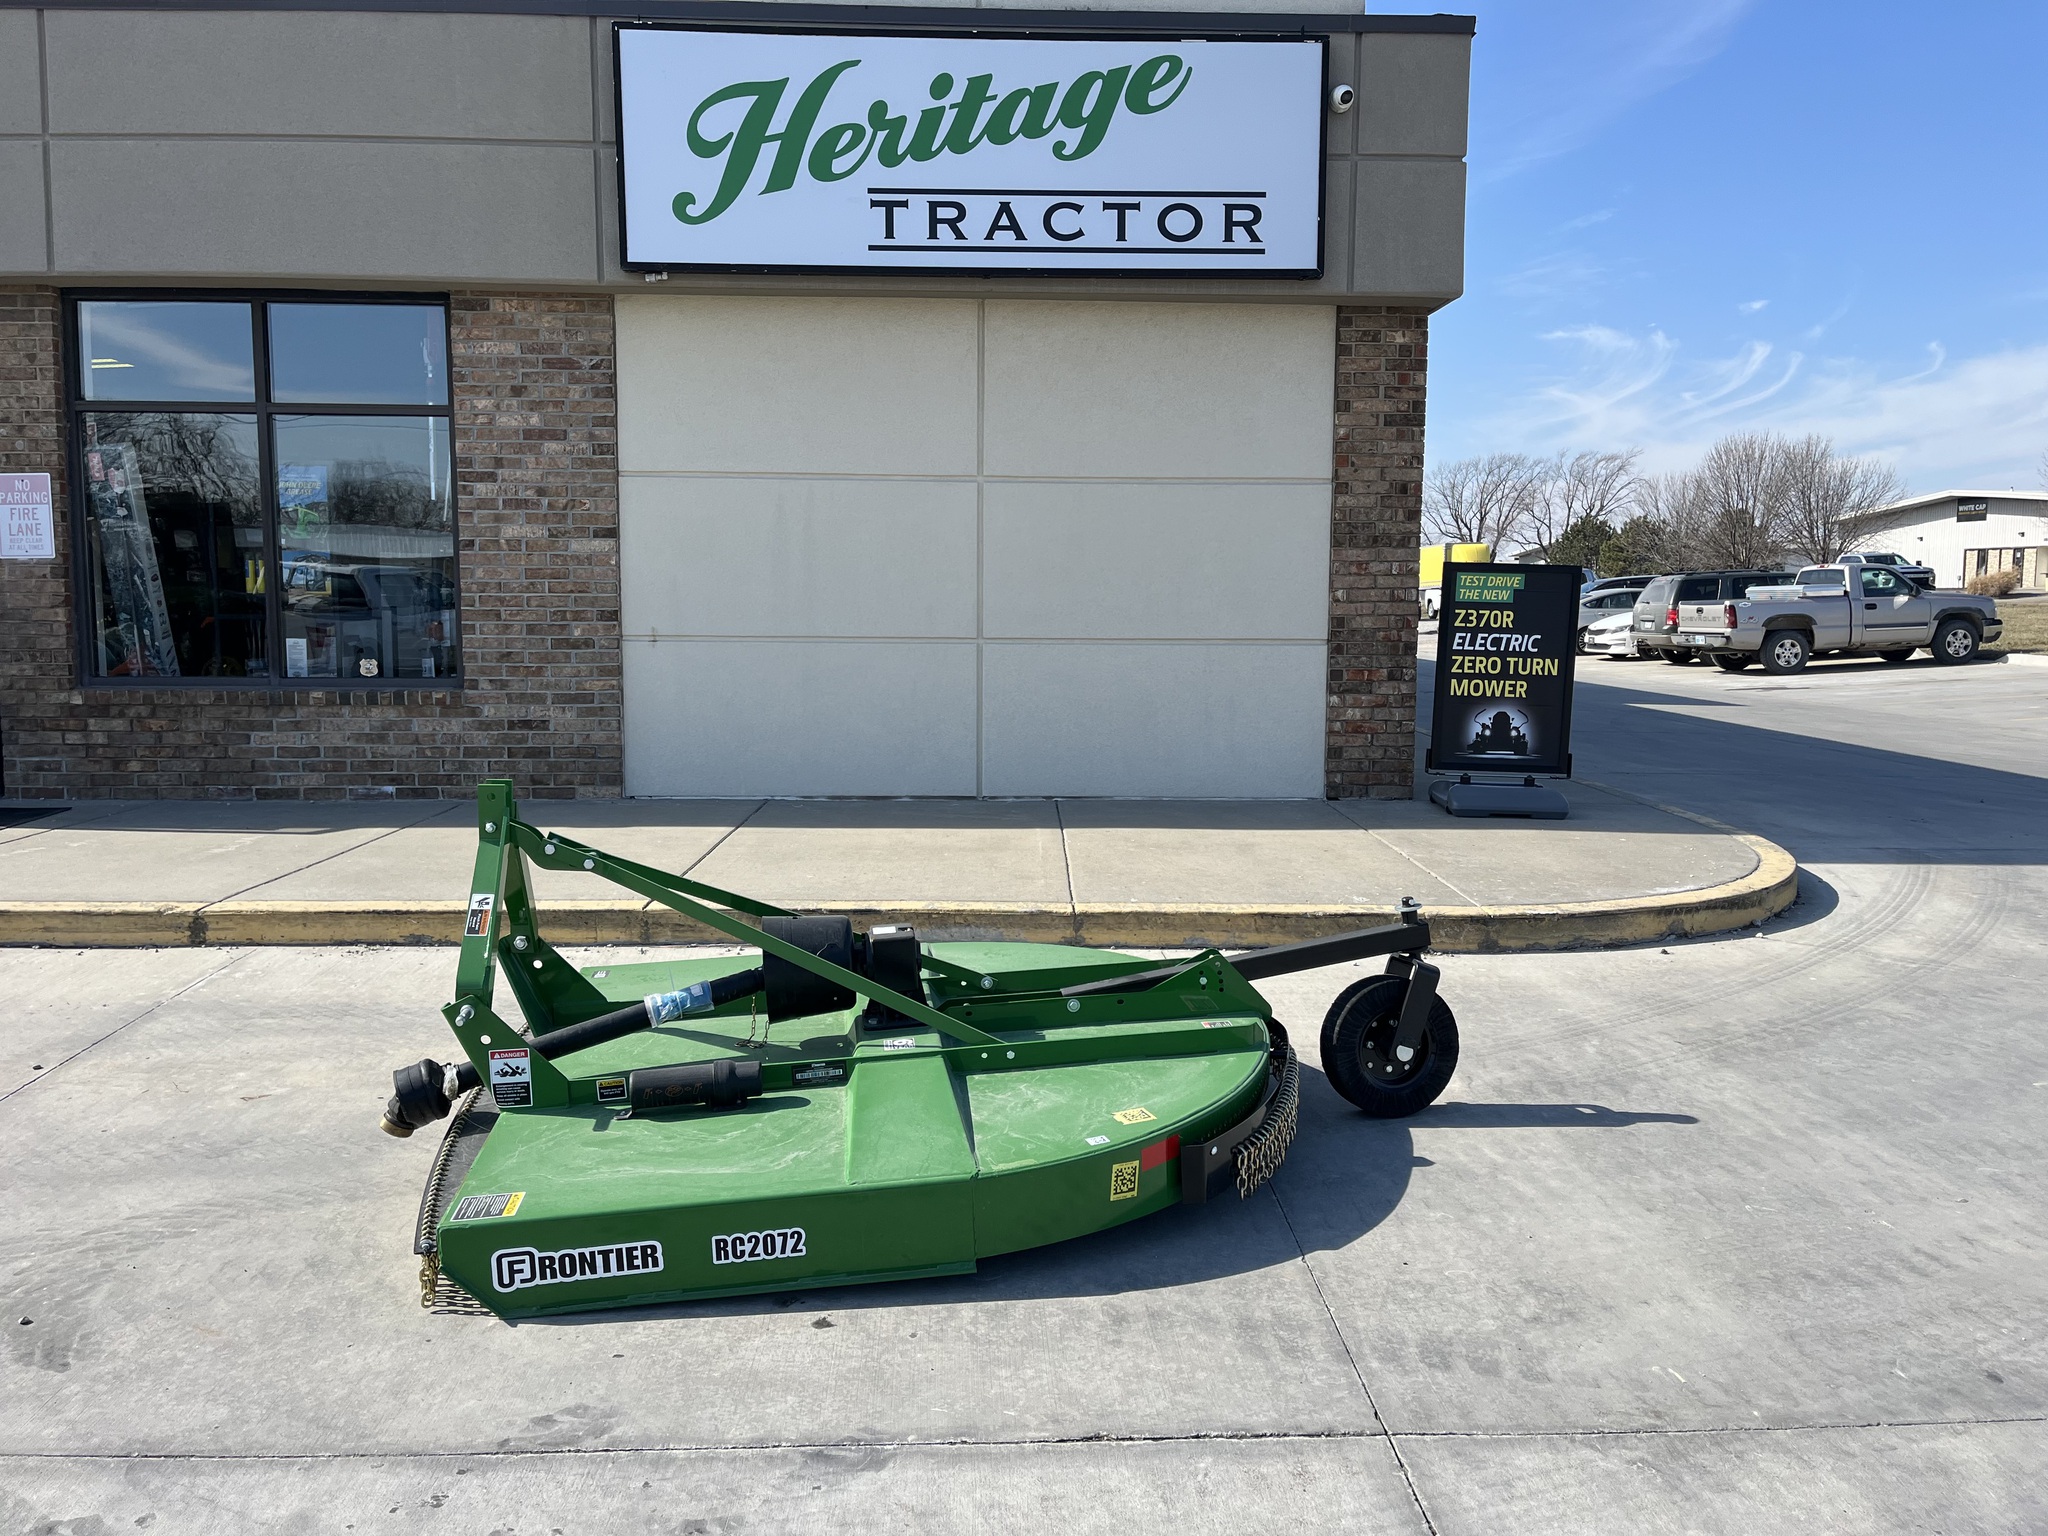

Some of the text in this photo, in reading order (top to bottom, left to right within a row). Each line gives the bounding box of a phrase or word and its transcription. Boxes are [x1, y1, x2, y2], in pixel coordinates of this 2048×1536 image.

[671, 53, 1192, 225] Heritage
[867, 198, 1264, 244] TRACTOR
[14, 479, 31, 491] NO
[0, 491, 48, 504] PARKING
[10, 507, 40, 521] FIRE
[8, 523, 43, 537] LANE
[1459, 575, 1521, 588] TEST DRIVE
[1458, 589, 1510, 601] THE NEW
[1454, 609, 1514, 628] Z370R
[1452, 632, 1541, 652] ELECTRIC
[1451, 655, 1559, 676] ZERO TURN
[1450, 678, 1528, 698] MOWER
[714, 1230, 803, 1261] RC2072
[496, 1244, 660, 1289] FRONTIER
